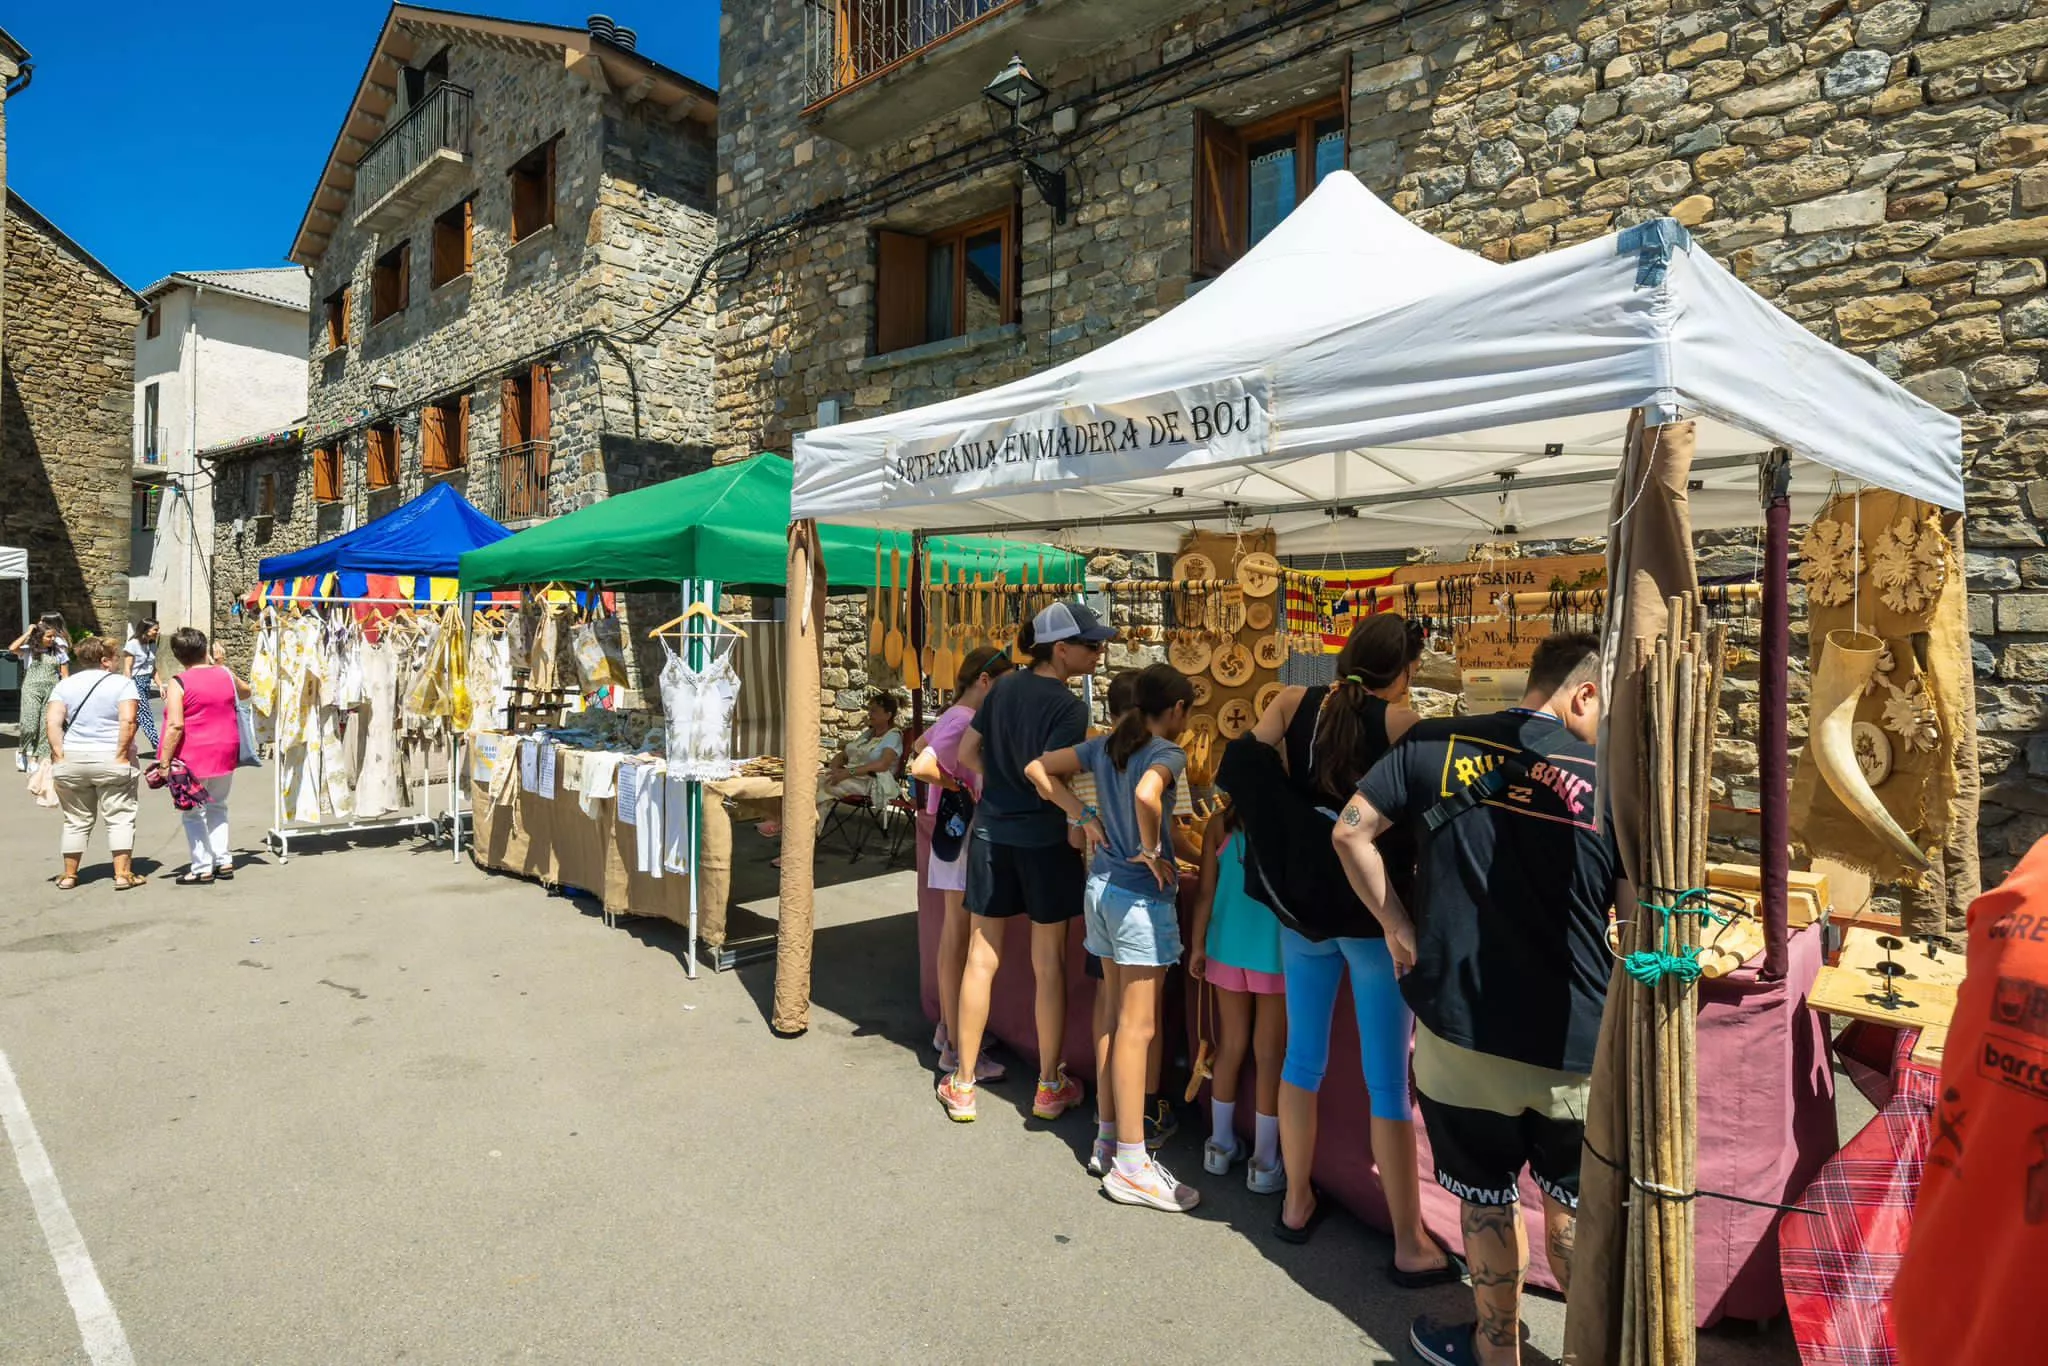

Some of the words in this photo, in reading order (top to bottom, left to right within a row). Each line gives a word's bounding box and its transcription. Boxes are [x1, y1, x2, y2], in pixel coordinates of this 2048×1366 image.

[893, 440, 998, 483] ARTESANIA
[1004, 431, 1031, 464] EN
[1036, 417, 1138, 460] MADERA
[1147, 411, 1188, 448] DE
[1191, 396, 1252, 442] BOJ
